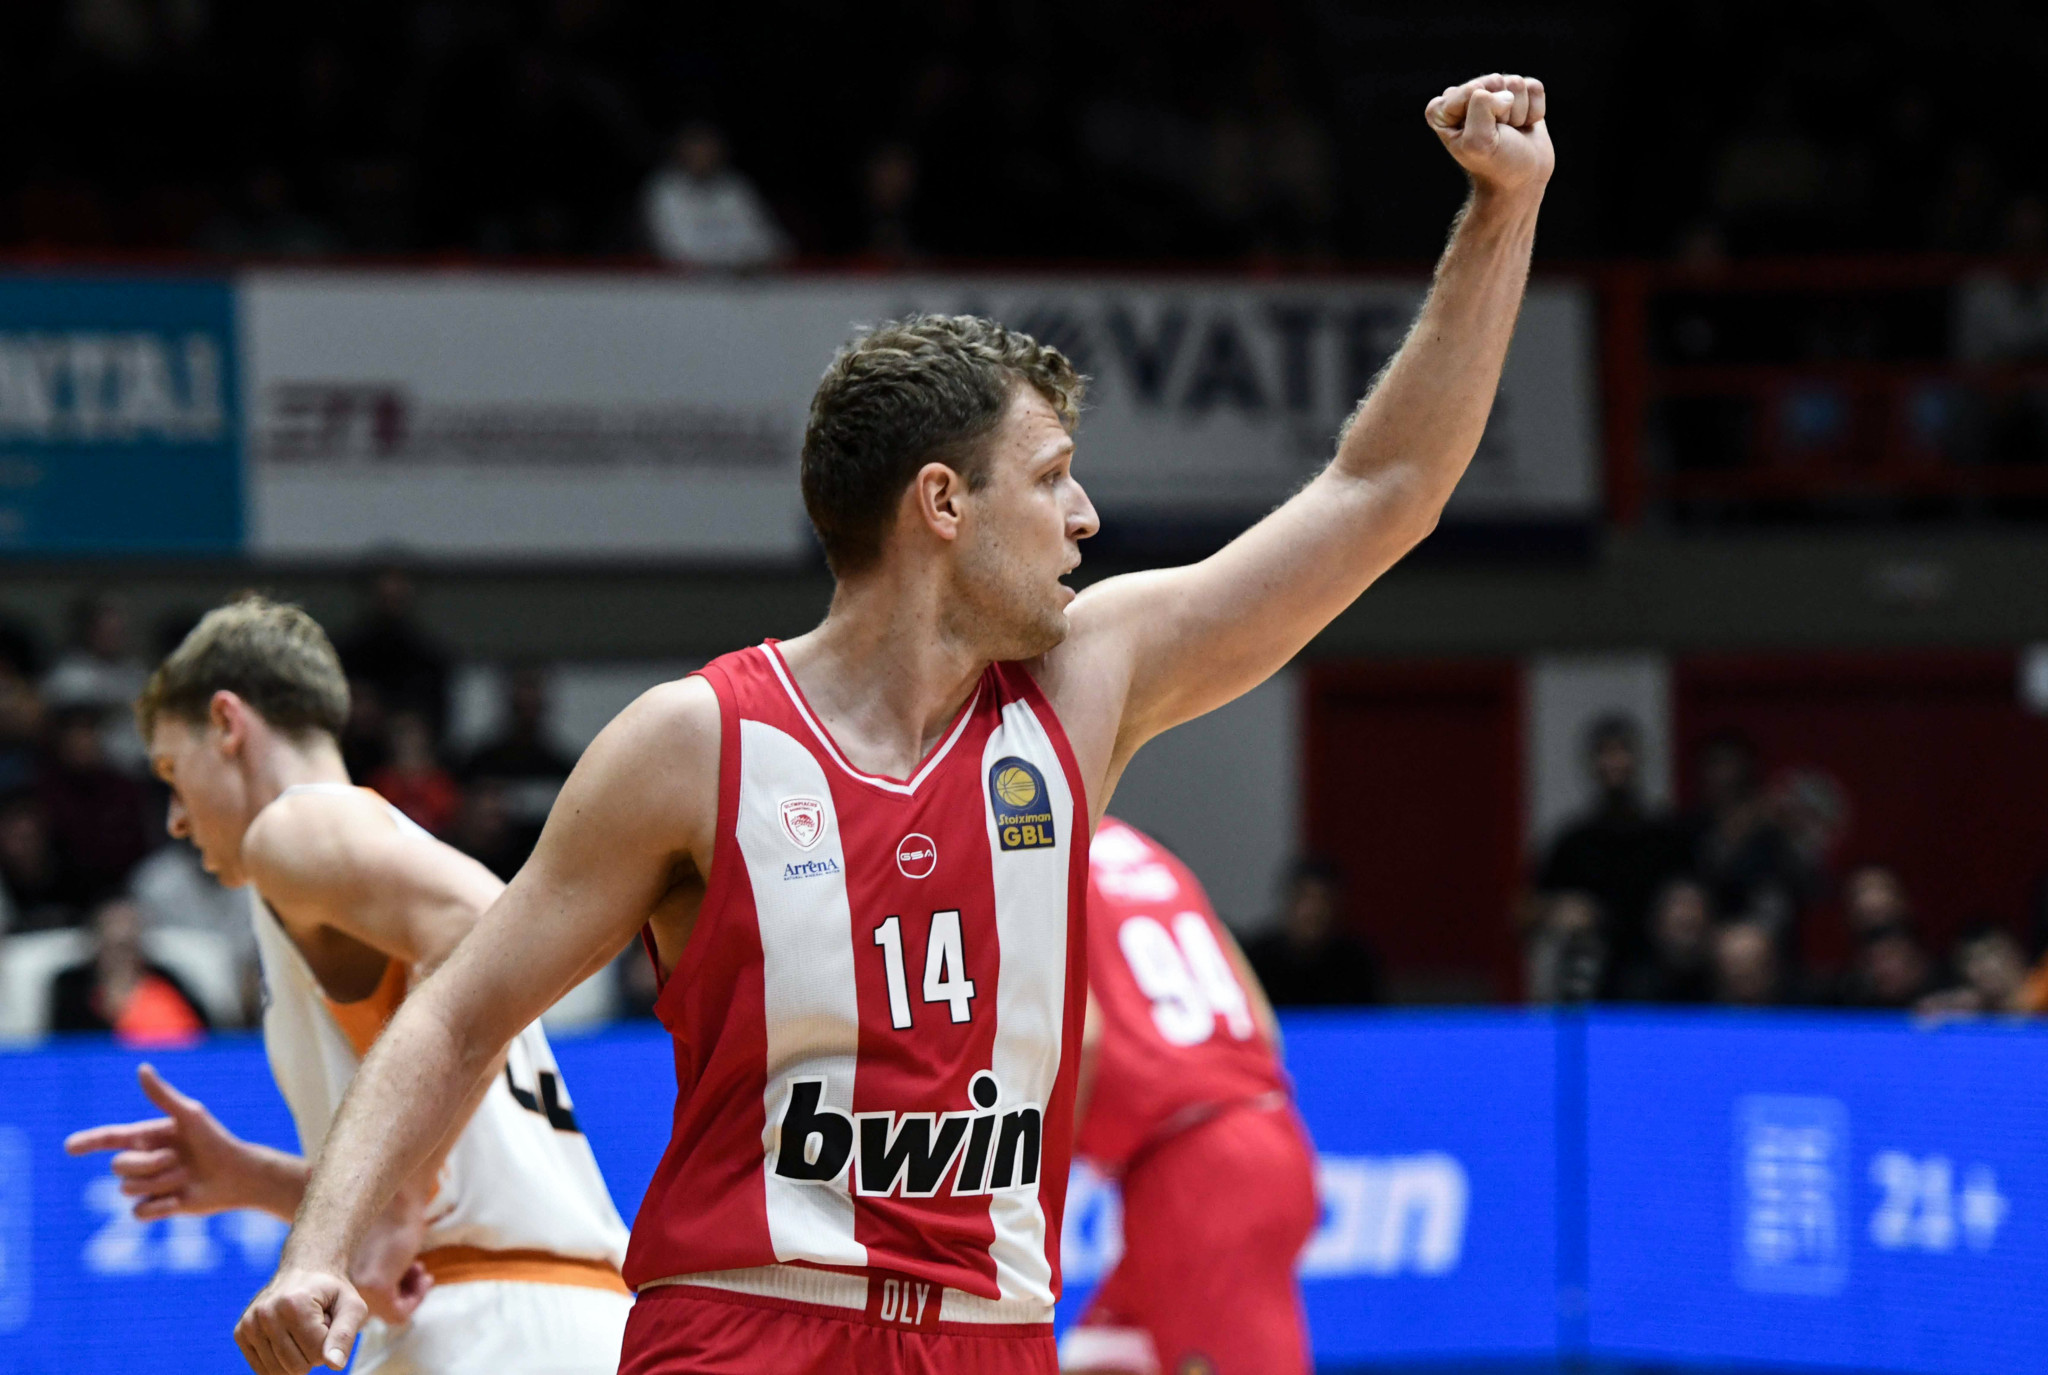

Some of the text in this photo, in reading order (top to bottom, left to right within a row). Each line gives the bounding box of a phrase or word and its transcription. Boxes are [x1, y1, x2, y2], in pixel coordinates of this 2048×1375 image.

[998, 813, 1051, 826] Stoiximan
[1003, 824, 1053, 847] GBL
[900, 849, 934, 861] GSA
[873, 909, 976, 1030] 14
[1118, 910, 1256, 1047] 94
[770, 1069, 1042, 1198] bwin
[880, 1278, 931, 1326] OLY
